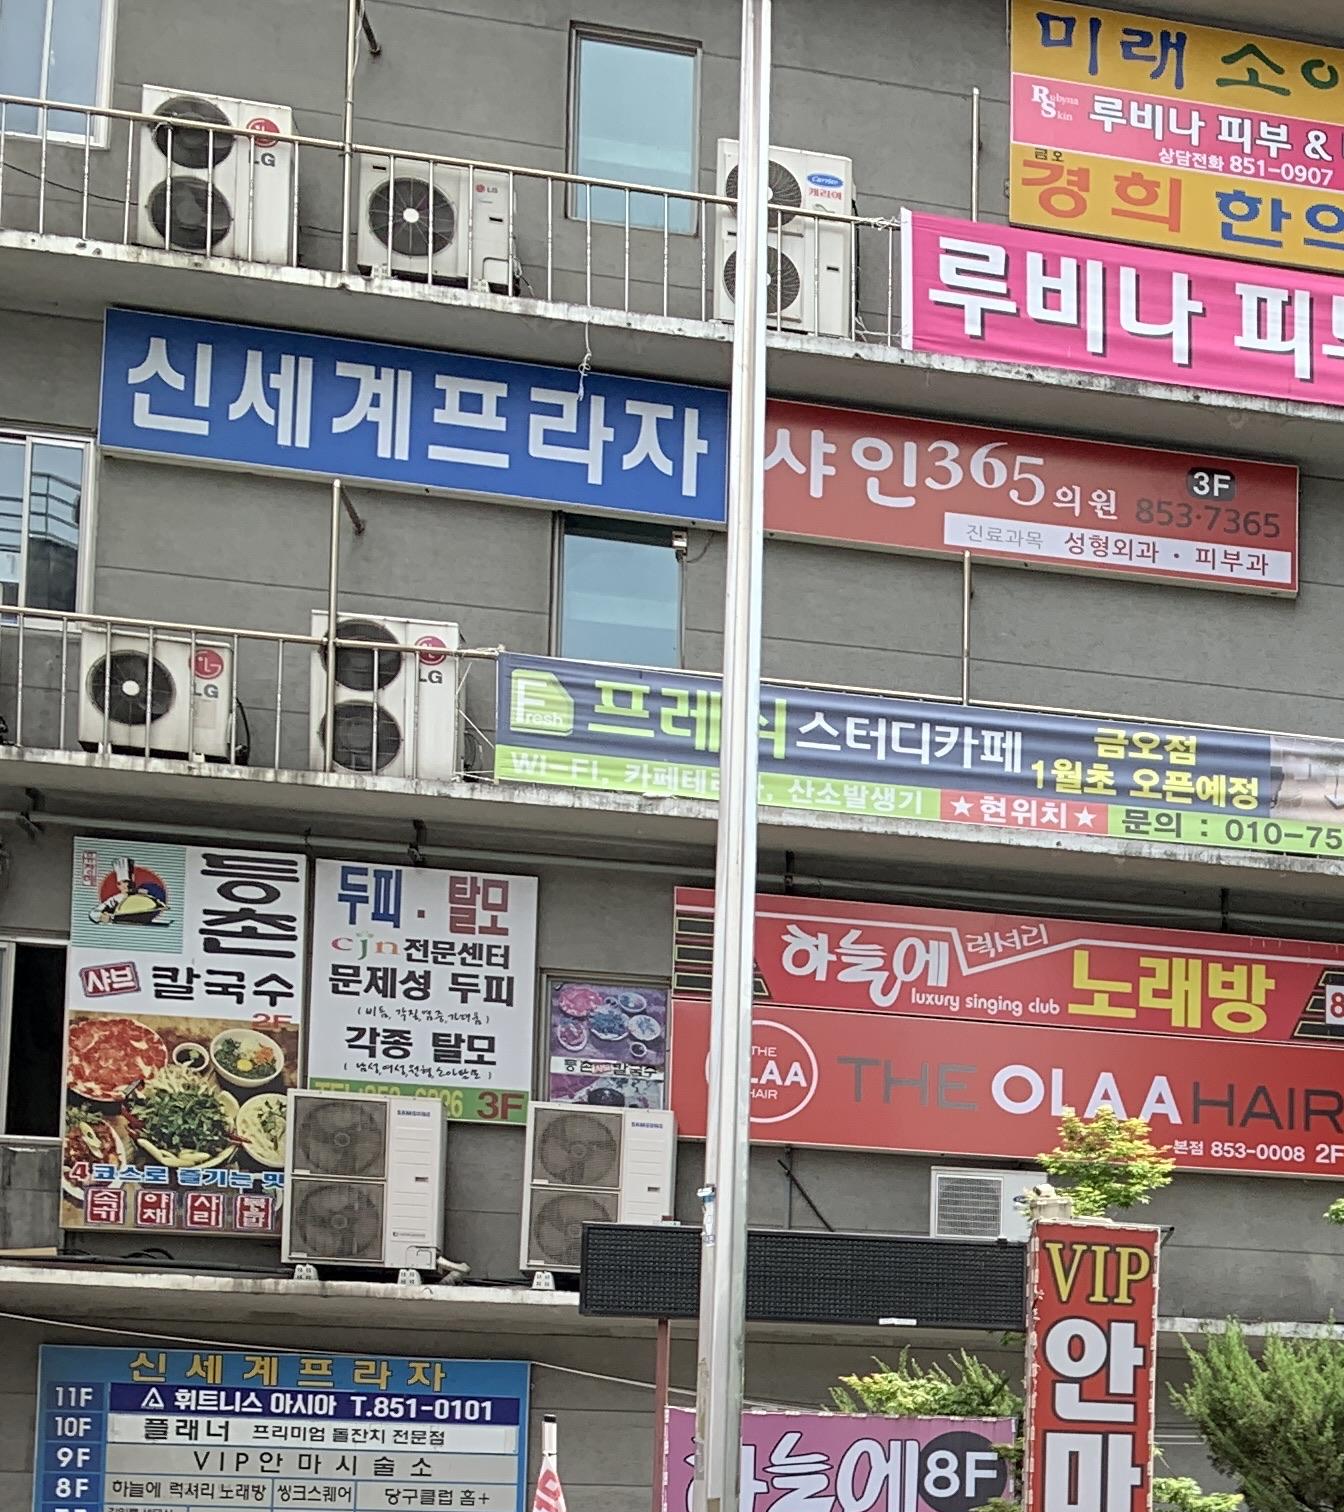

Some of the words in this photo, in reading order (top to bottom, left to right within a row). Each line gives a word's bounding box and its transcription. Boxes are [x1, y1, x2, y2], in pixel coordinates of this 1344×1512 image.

[1036, 12, 1187, 90] 미래
[1041, 100, 1073, 121] Skin
[1090, 95, 1205, 145] 루비나
[1217, 115, 1292, 159] 피부
[1305, 130, 1333, 161] &
[1159, 147, 1225, 173] 상담전화
[1229, 155, 1333, 187] 851-0907
[1021, 160, 1182, 232] 경희
[930, 238, 1203, 365] 루비나
[127, 337, 709, 497] 신세계프라자
[764, 429, 1046, 508] 샤인365
[1052, 485, 1118, 520] 의원
[1193, 470, 1232, 496] 3F
[966, 523, 1043, 549] 진료과목
[1064, 532, 1160, 563] 성형외과
[1195, 547, 1269, 577] 피부과
[796, 711, 1022, 773] 스터디카페
[1094, 727, 1197, 766] 금오점
[788, 779, 922, 815] 산소발생기
[1031, 759, 1117, 796] 1월초
[1132, 768, 1258, 811] 오픈예정
[979, 797, 1068, 829] 현위치
[1120, 808, 1182, 838] 문의
[199, 853, 299, 958] 등촌
[338, 866, 402, 928] 두피
[449, 876, 509, 936] 탈모
[404, 937, 510, 969] 전문센터
[87, 966, 136, 993] 샤브
[152, 966, 294, 1007] 칼국수
[329, 963, 431, 1001] 문제성
[449, 972, 514, 1007] 두피
[781, 924, 950, 1007] 하늘에
[1068, 950, 1275, 1033] 노래방
[911, 987, 960, 1011] luxury
[965, 993, 1023, 1018] singing
[1028, 1000, 1060, 1015] club
[345, 1026, 413, 1060] 각종
[432, 1032, 496, 1065] 탈모
[477, 1090, 524, 1120] 3F
[837, 1057, 979, 1110] THE
[992, 1065, 1182, 1125] OLAA
[1191, 1081, 1344, 1134] HAIR
[1172, 1140, 1204, 1156] 본점
[1210, 1141, 1305, 1161] 853-0008
[71, 1162, 89, 1181] 4
[92, 1163, 169, 1183] 코스로
[178, 1167, 252, 1188] 즐기는
[1045, 1242, 1151, 1304] VIP
[129, 1351, 446, 1392] 신세계프라자
[55, 1387, 93, 1407] 11F
[174, 1389, 263, 1412] 휘트니스
[270, 1392, 337, 1416] 아시아
[350, 1396, 492, 1421] T.851-0101
[55, 1417, 92, 1437] 10F
[144, 1418, 229, 1442] 플래너
[253, 1425, 325, 1442] 프리미엄
[332, 1427, 385, 1444] 돌잔치
[392, 1429, 445, 1445] 전문점
[57, 1448, 90, 1468] 9F
[923, 1450, 999, 1498] 8F
[55, 1478, 89, 1498] 8F
[112, 1480, 161, 1497] 하늘에
[169, 1482, 214, 1499] 럭셔리
[219, 1484, 266, 1501] 노래방
[277, 1485, 352, 1503] 씽크스퀘어
[385, 1489, 453, 1505] 당구클럽
